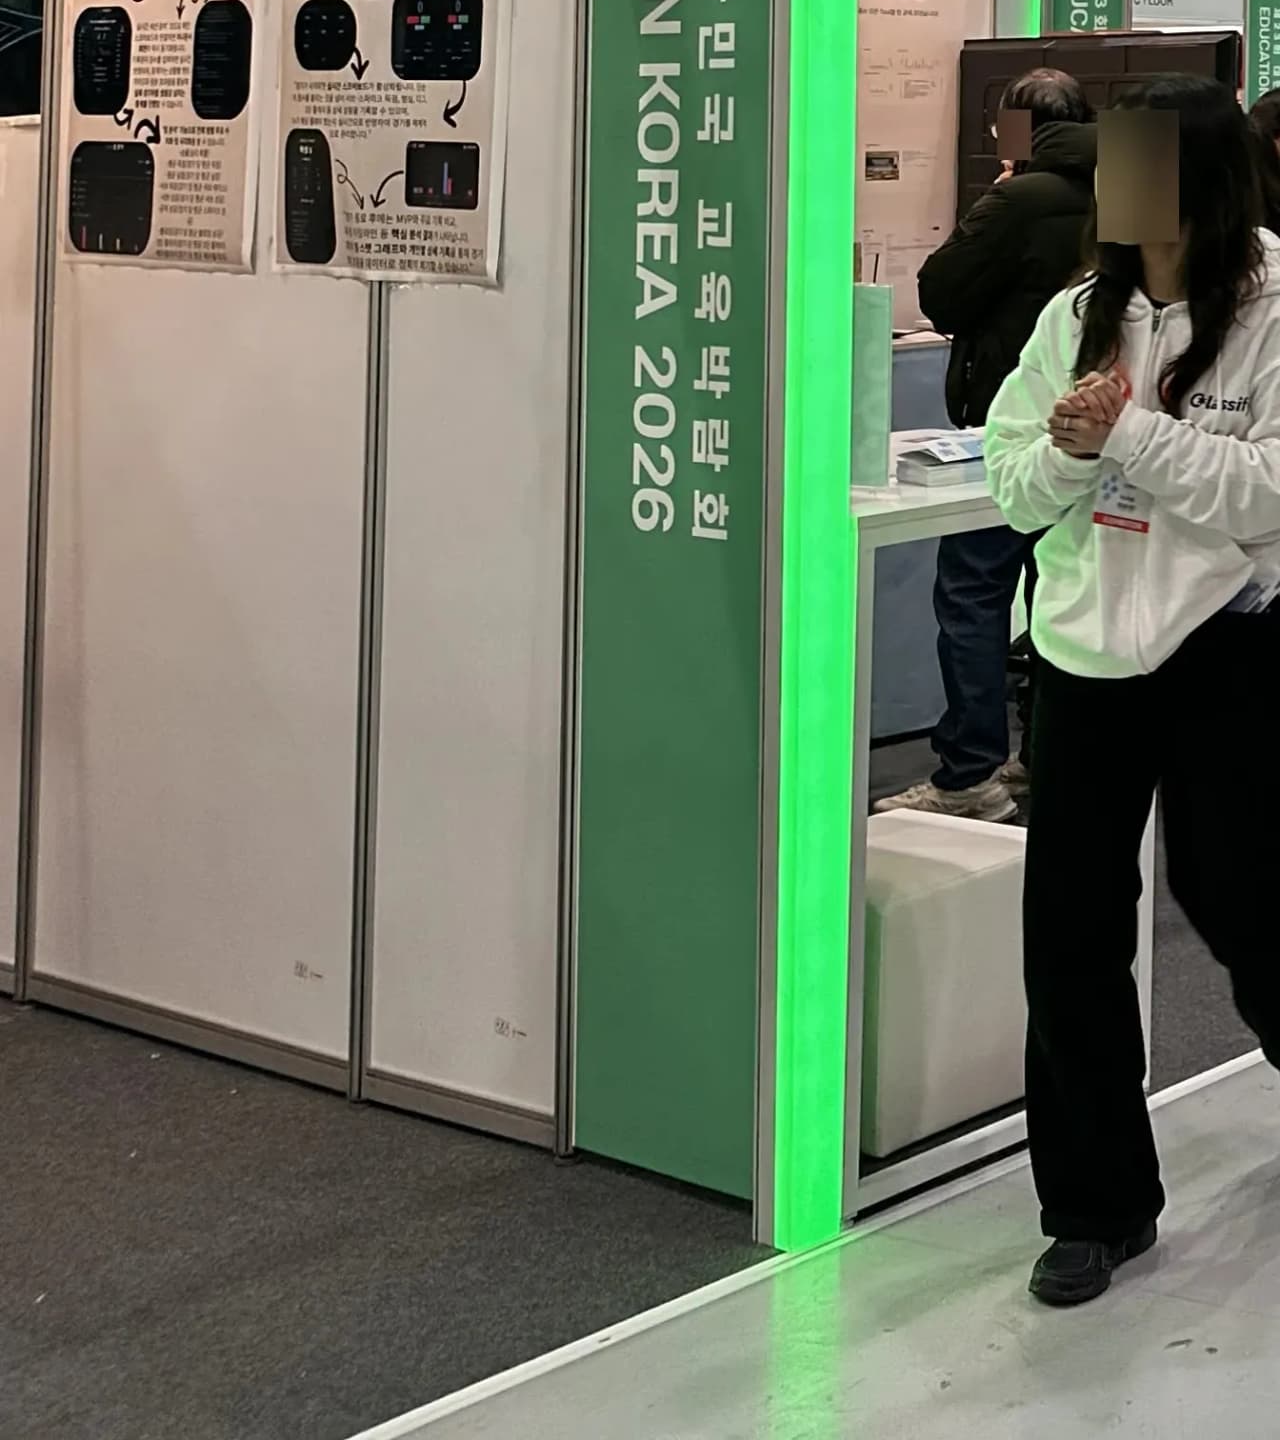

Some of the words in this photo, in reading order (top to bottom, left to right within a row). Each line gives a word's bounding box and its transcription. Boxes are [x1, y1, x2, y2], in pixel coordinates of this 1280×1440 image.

[635, 63, 680, 319] KOREA
[632, 346, 676, 531] 2026
[692, 200, 732, 539] 교육박람회
